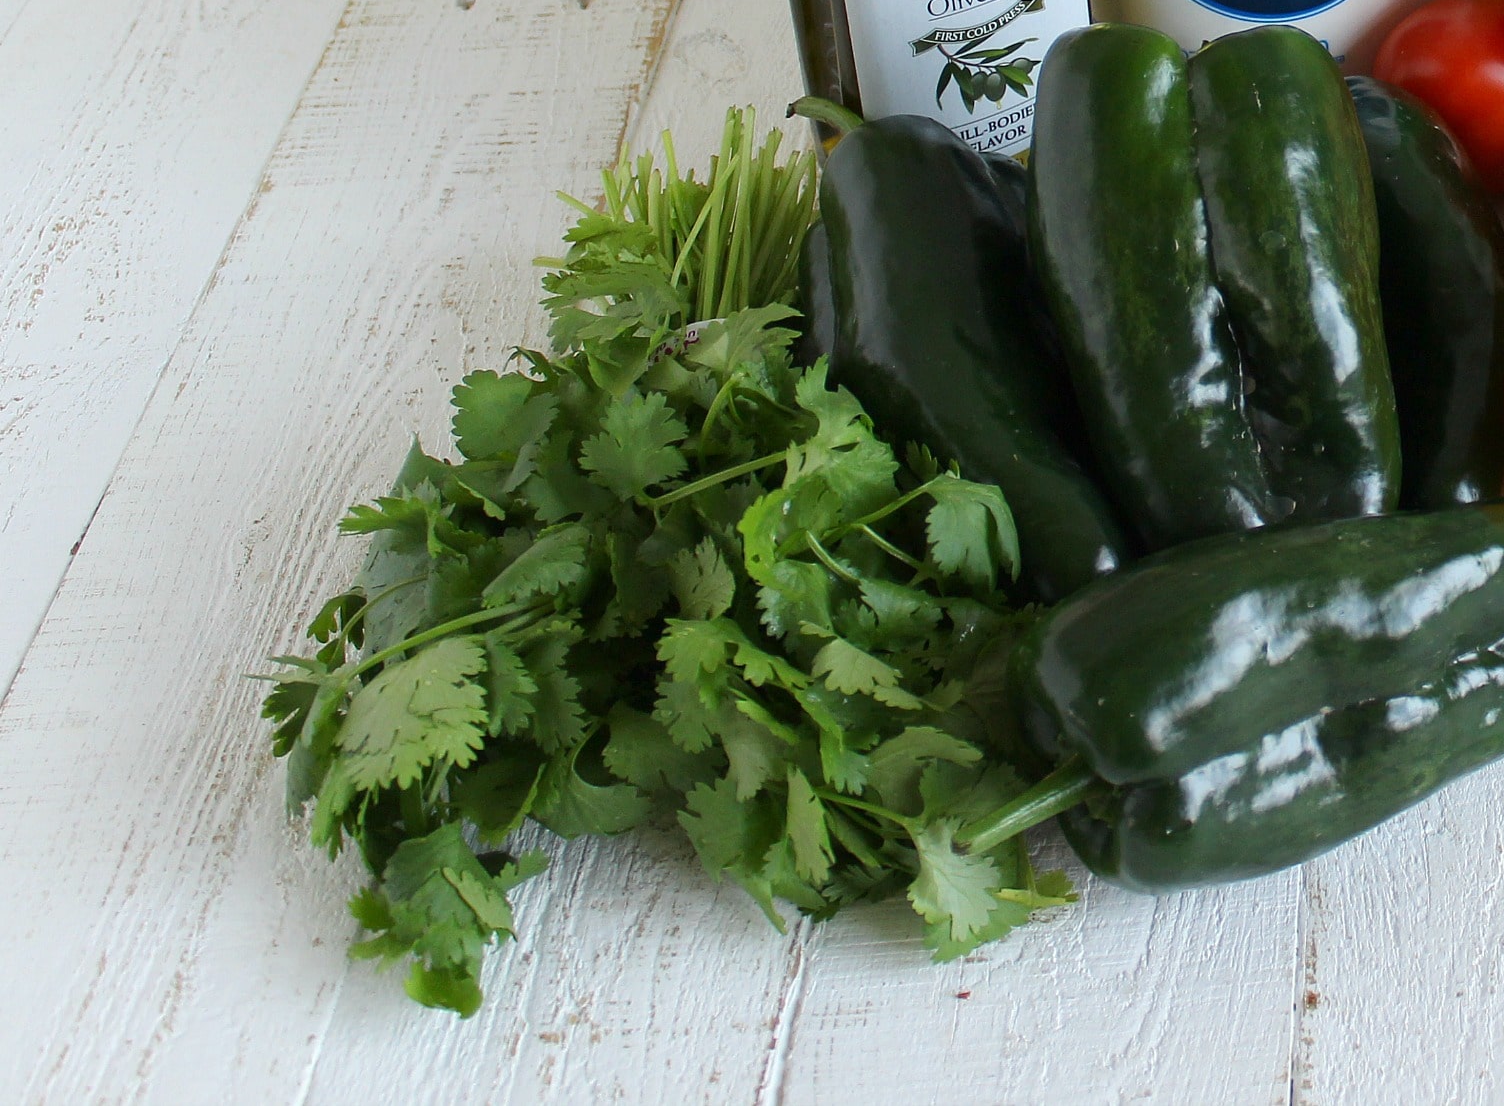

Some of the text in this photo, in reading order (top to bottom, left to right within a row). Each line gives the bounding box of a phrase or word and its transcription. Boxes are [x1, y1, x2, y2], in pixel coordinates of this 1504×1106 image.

[934, 0, 1026, 42] FIRST COLD PRESS
